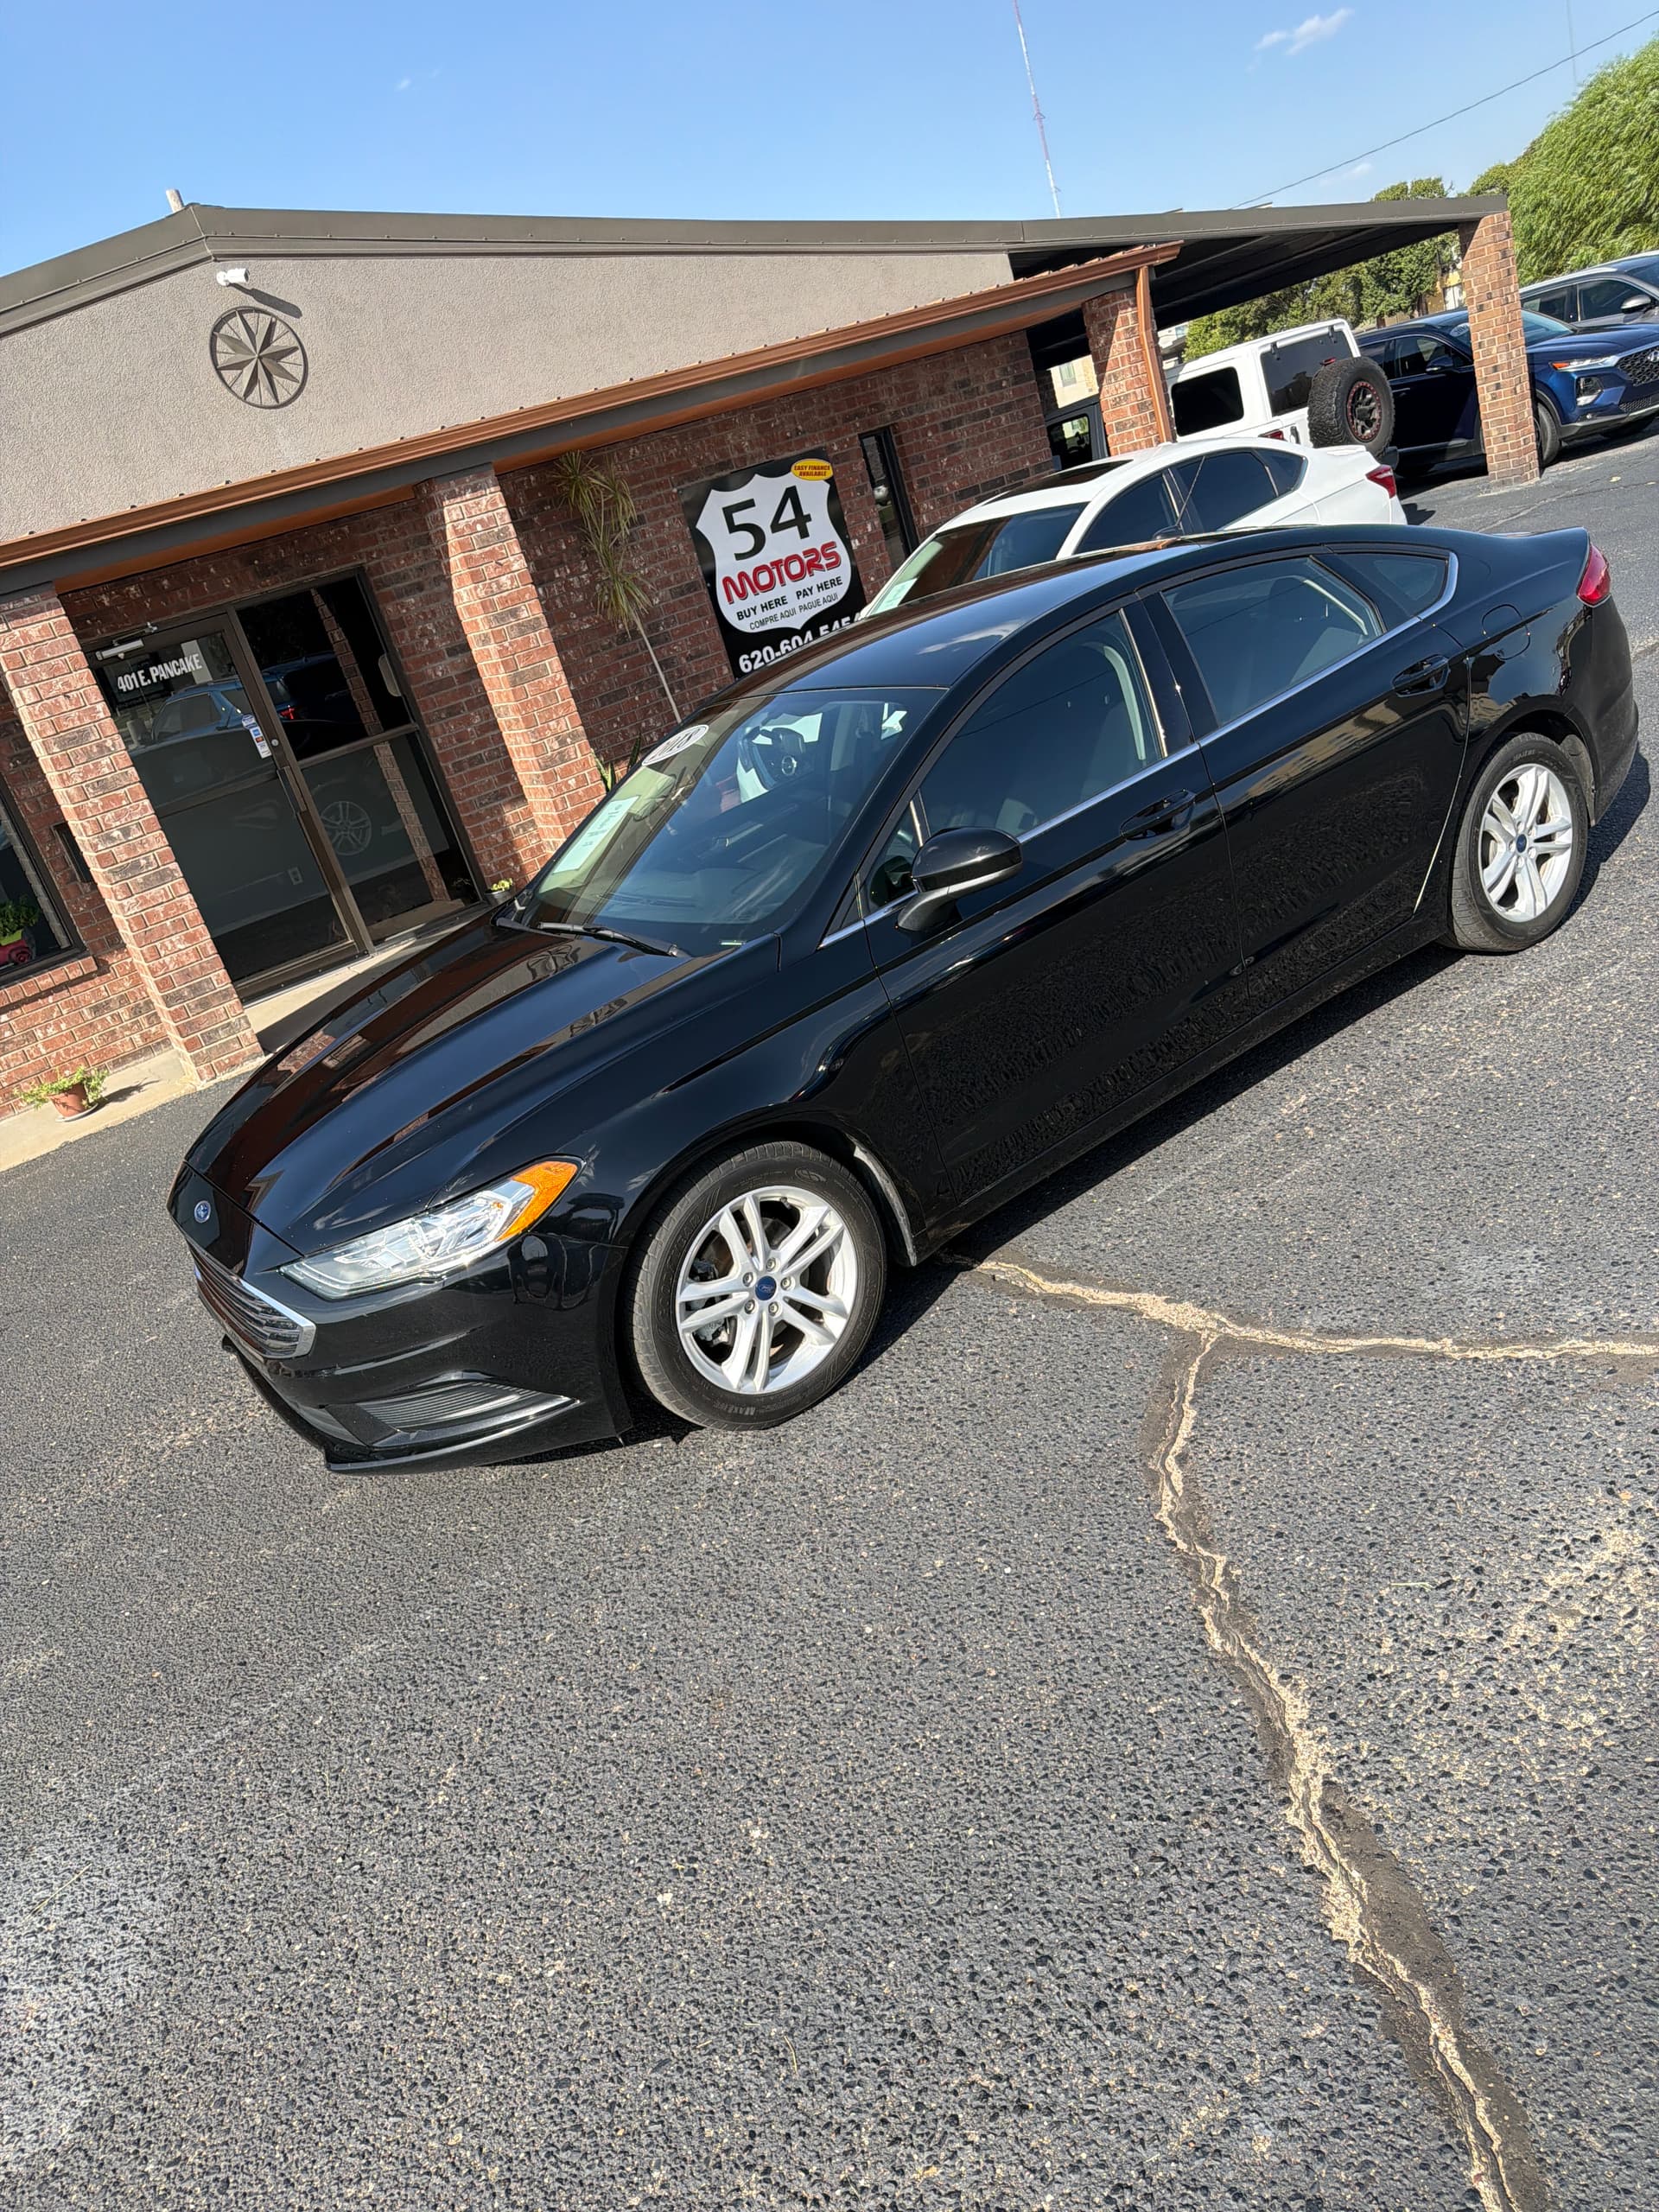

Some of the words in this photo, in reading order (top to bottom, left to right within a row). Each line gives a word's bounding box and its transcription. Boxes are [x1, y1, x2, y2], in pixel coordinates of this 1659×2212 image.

[722, 485, 811, 561] 54
[722, 541, 842, 605] MOTORS
[736, 606, 757, 621] BUY
[760, 595, 788, 613] HERE
[796, 586, 814, 600] PAY
[817, 576, 843, 593] HERE
[750, 613, 779, 630] COMPRE
[780, 608, 797, 620] AQUI
[798, 599, 822, 613] PAGUE
[823, 593, 838, 605] AQUI
[118, 672, 140, 691] 401
[137, 670, 151, 687] E.
[149, 653, 202, 683] PANCAKE
